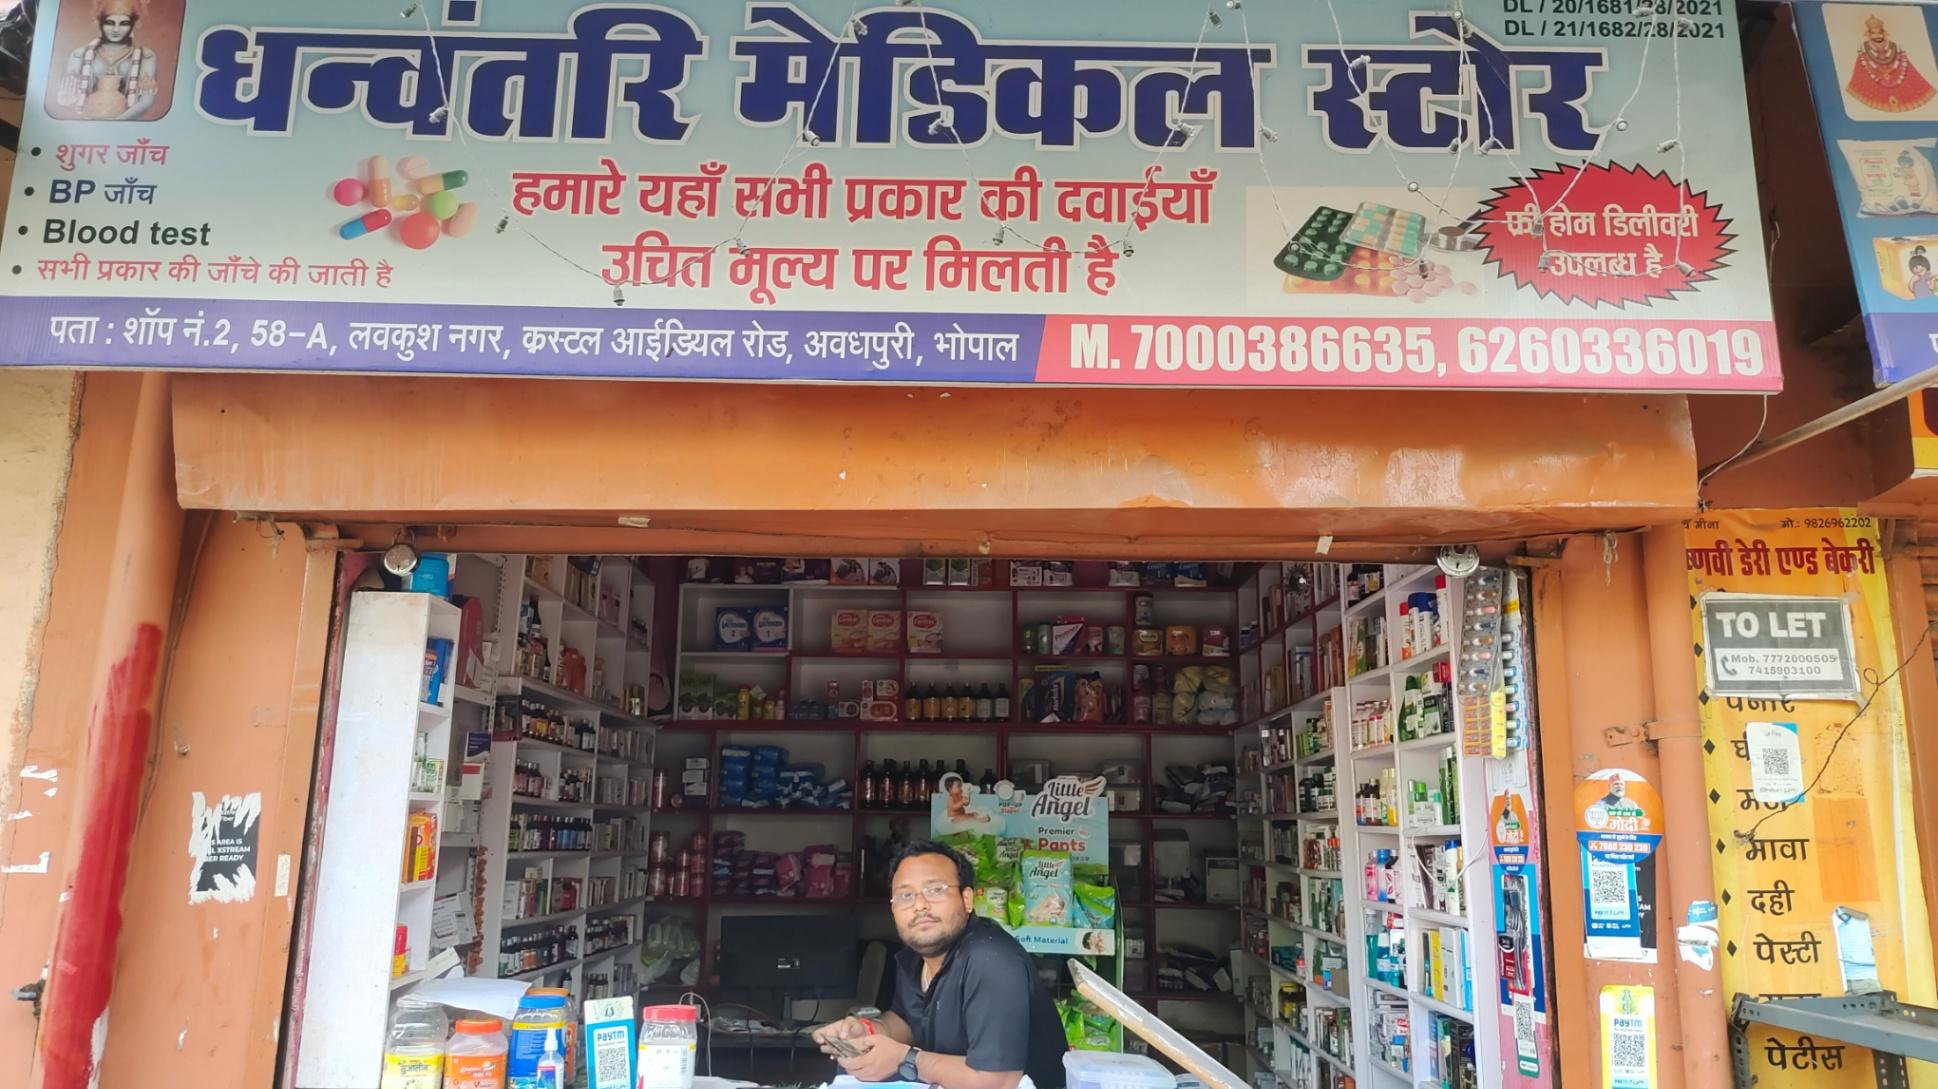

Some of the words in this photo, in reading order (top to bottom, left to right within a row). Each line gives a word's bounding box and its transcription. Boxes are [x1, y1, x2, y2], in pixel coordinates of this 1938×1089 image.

[1504, 0, 1532, 13] DL
[1505, 20, 1534, 36] DL
[1541, 20, 1547, 36] /
[196, 0, 707, 145] धन्वंतरि
[732, 3, 1276, 151] मेडिकल
[1302, 11, 1608, 155] स्टोर
[56, 144, 110, 171] शुगर
[116, 138, 170, 165] जाँच
[49, 179, 96, 204] BP
[105, 177, 157, 205] जाँच
[512, 159, 627, 217] हमारे
[638, 161, 727, 219] यहाँ
[734, 162, 832, 219] सभी
[845, 178, 967, 223] प्रकार
[978, 165, 1043, 222] की
[1054, 165, 1218, 231] दवाईयाँ
[43, 219, 140, 245] Blood
[150, 221, 210, 246] test
[1549, 204, 1596, 237] होम
[1603, 204, 1699, 238] डिलीवरी
[37, 252, 90, 281] सभी
[97, 259, 161, 282] प्रकार
[169, 254, 201, 283] की
[208, 255, 261, 284] जाँचे
[268, 256, 300, 285] की
[308, 258, 369, 287] जाती
[376, 259, 394, 289] है
[602, 230, 716, 288] उचित
[728, 246, 839, 306] मूल्य
[852, 249, 913, 291] पर
[923, 235, 1072, 293] मिलती
[1084, 234, 1120, 297] है
[1550, 251, 1637, 278] उपलब्ध
[1644, 243, 1664, 279] है
[50, 316, 100, 344] पता
[123, 307, 177, 346] शॉप
[349, 322, 442, 362] लवकुश
[449, 324, 511, 360] नगर,
[742, 320, 792, 365] रोड,
[804, 321, 923, 370] अवधपुरी,
[934, 323, 1020, 361] भोपाल
[1071, 323, 1120, 369] M.
[1131, 323, 1447, 378] 7000386635,
[1457, 326, 1764, 376] 6260336019
[1804, 518, 1872, 529] 9826962202
[1735, 538, 1771, 576] डेरी
[1775, 547, 1819, 575] एण्ड
[1821, 537, 1875, 574] बेकरी
[1715, 612, 1760, 638] TO
[1768, 612, 1827, 638] LET
[1731, 654, 1759, 664] Mob.
[1748, 666, 1822, 675] 7415903100
[1048, 782, 1084, 800] Little
[1031, 794, 1091, 822] Angel
[1039, 827, 1074, 836] Premier
[1039, 838, 1086, 852] Pants
[1745, 838, 1809, 861] मावा
[1029, 867, 1059, 880] Angel
[1747, 879, 1795, 915] दही
[1034, 935, 1069, 945] Material
[1753, 931, 1821, 965] पेस्टी
[1764, 1037, 1846, 1071] पेटीस
